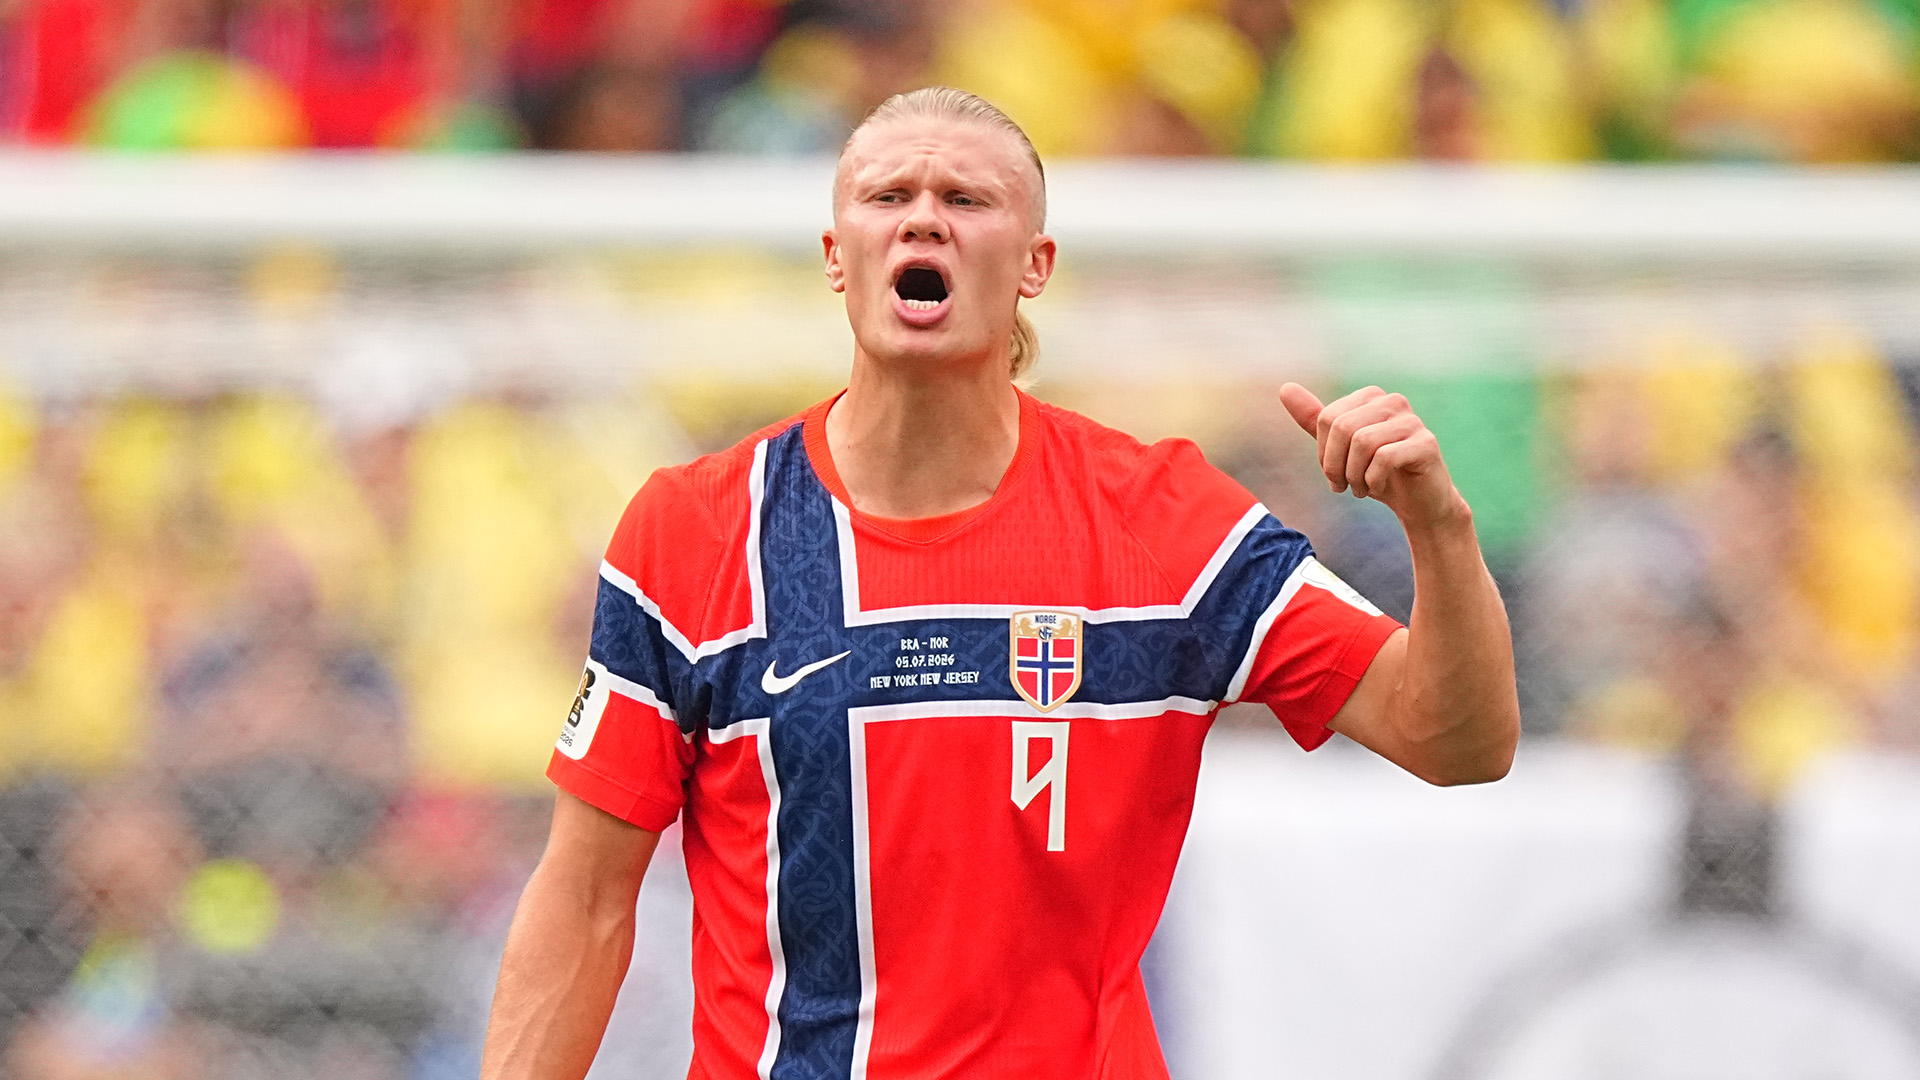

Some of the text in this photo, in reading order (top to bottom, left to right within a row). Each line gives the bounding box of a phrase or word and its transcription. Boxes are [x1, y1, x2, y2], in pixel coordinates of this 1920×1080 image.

[1034, 614, 1057, 624] NORGE
[900, 638, 920, 651] BRA
[929, 636, 949, 649] NOR
[895, 653, 955, 669] 05.07.2026
[870, 670, 980, 689] NEW YORK NEW JERSEY
[1010, 720, 1071, 852] 9
